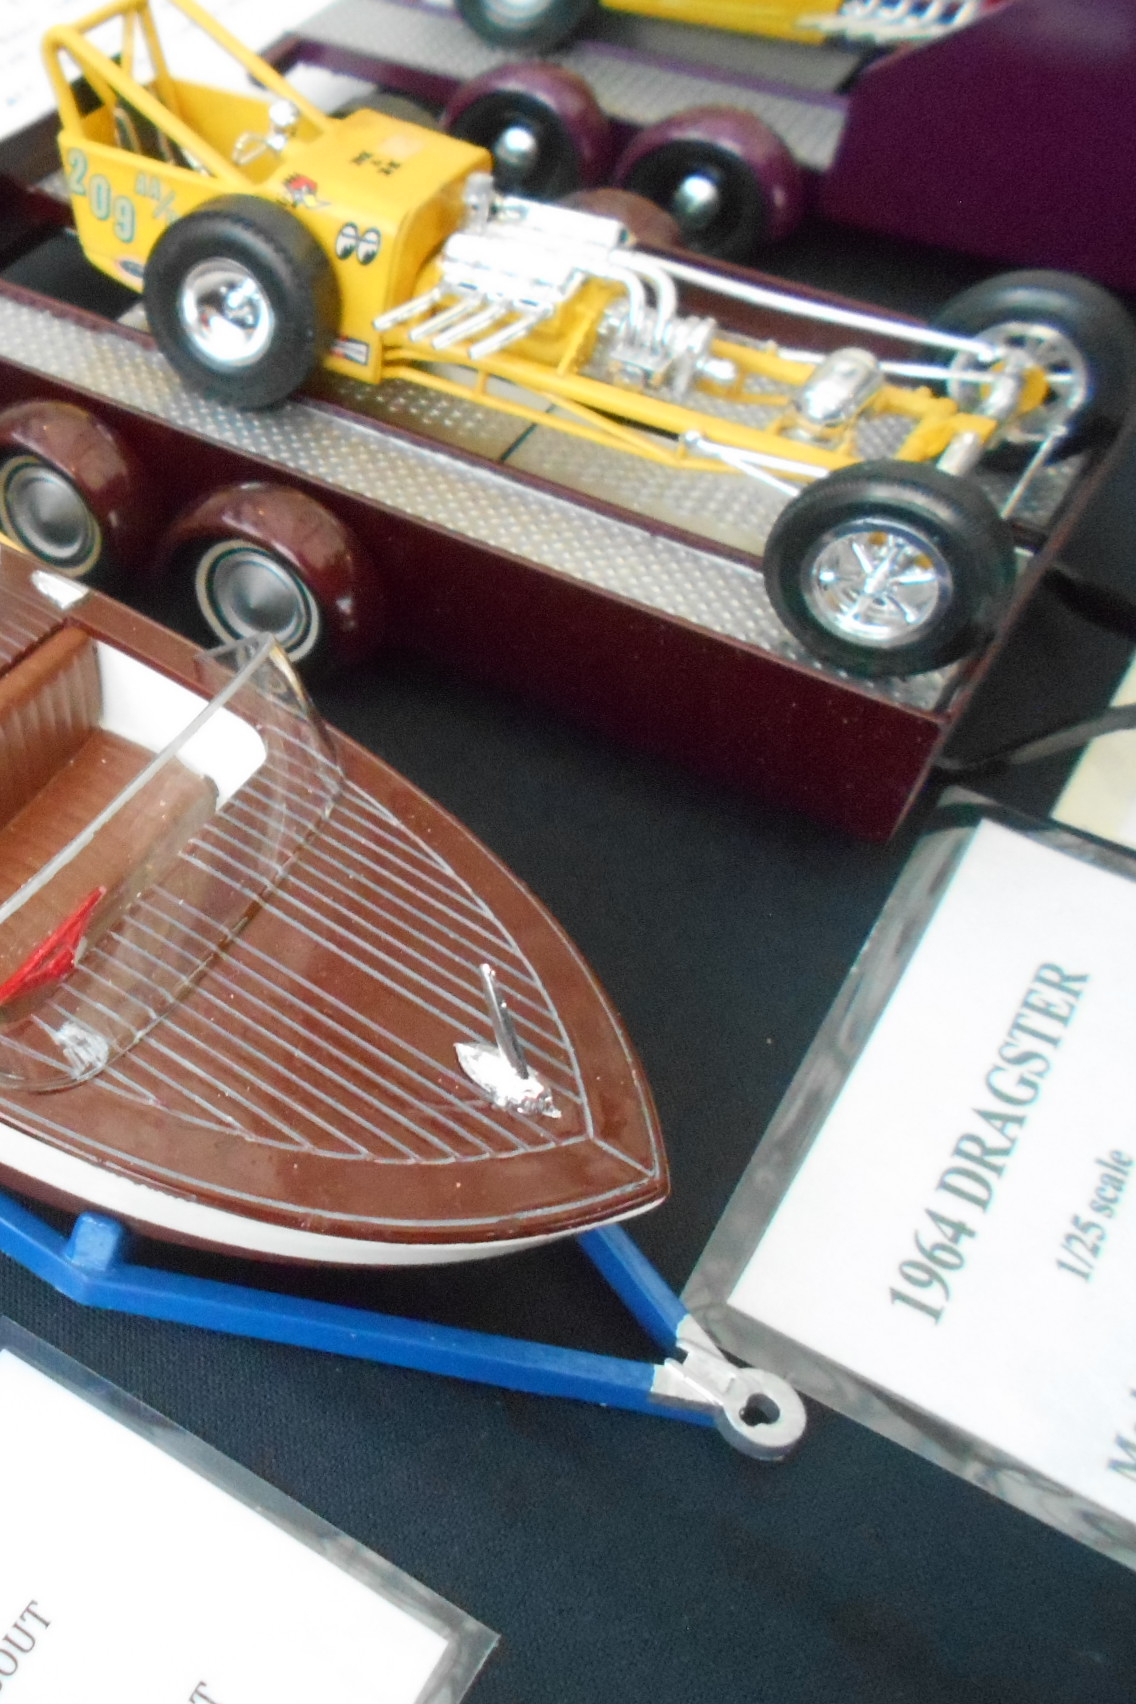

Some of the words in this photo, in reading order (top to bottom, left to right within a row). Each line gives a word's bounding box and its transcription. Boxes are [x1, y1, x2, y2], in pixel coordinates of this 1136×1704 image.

[67, 147, 136, 243] 209
[890, 1208, 976, 1326] 1964
[937, 962, 1090, 1213] DRAGSTER
[1055, 1214, 1107, 1285] 1/25
[1088, 1148, 1133, 1219] scale
